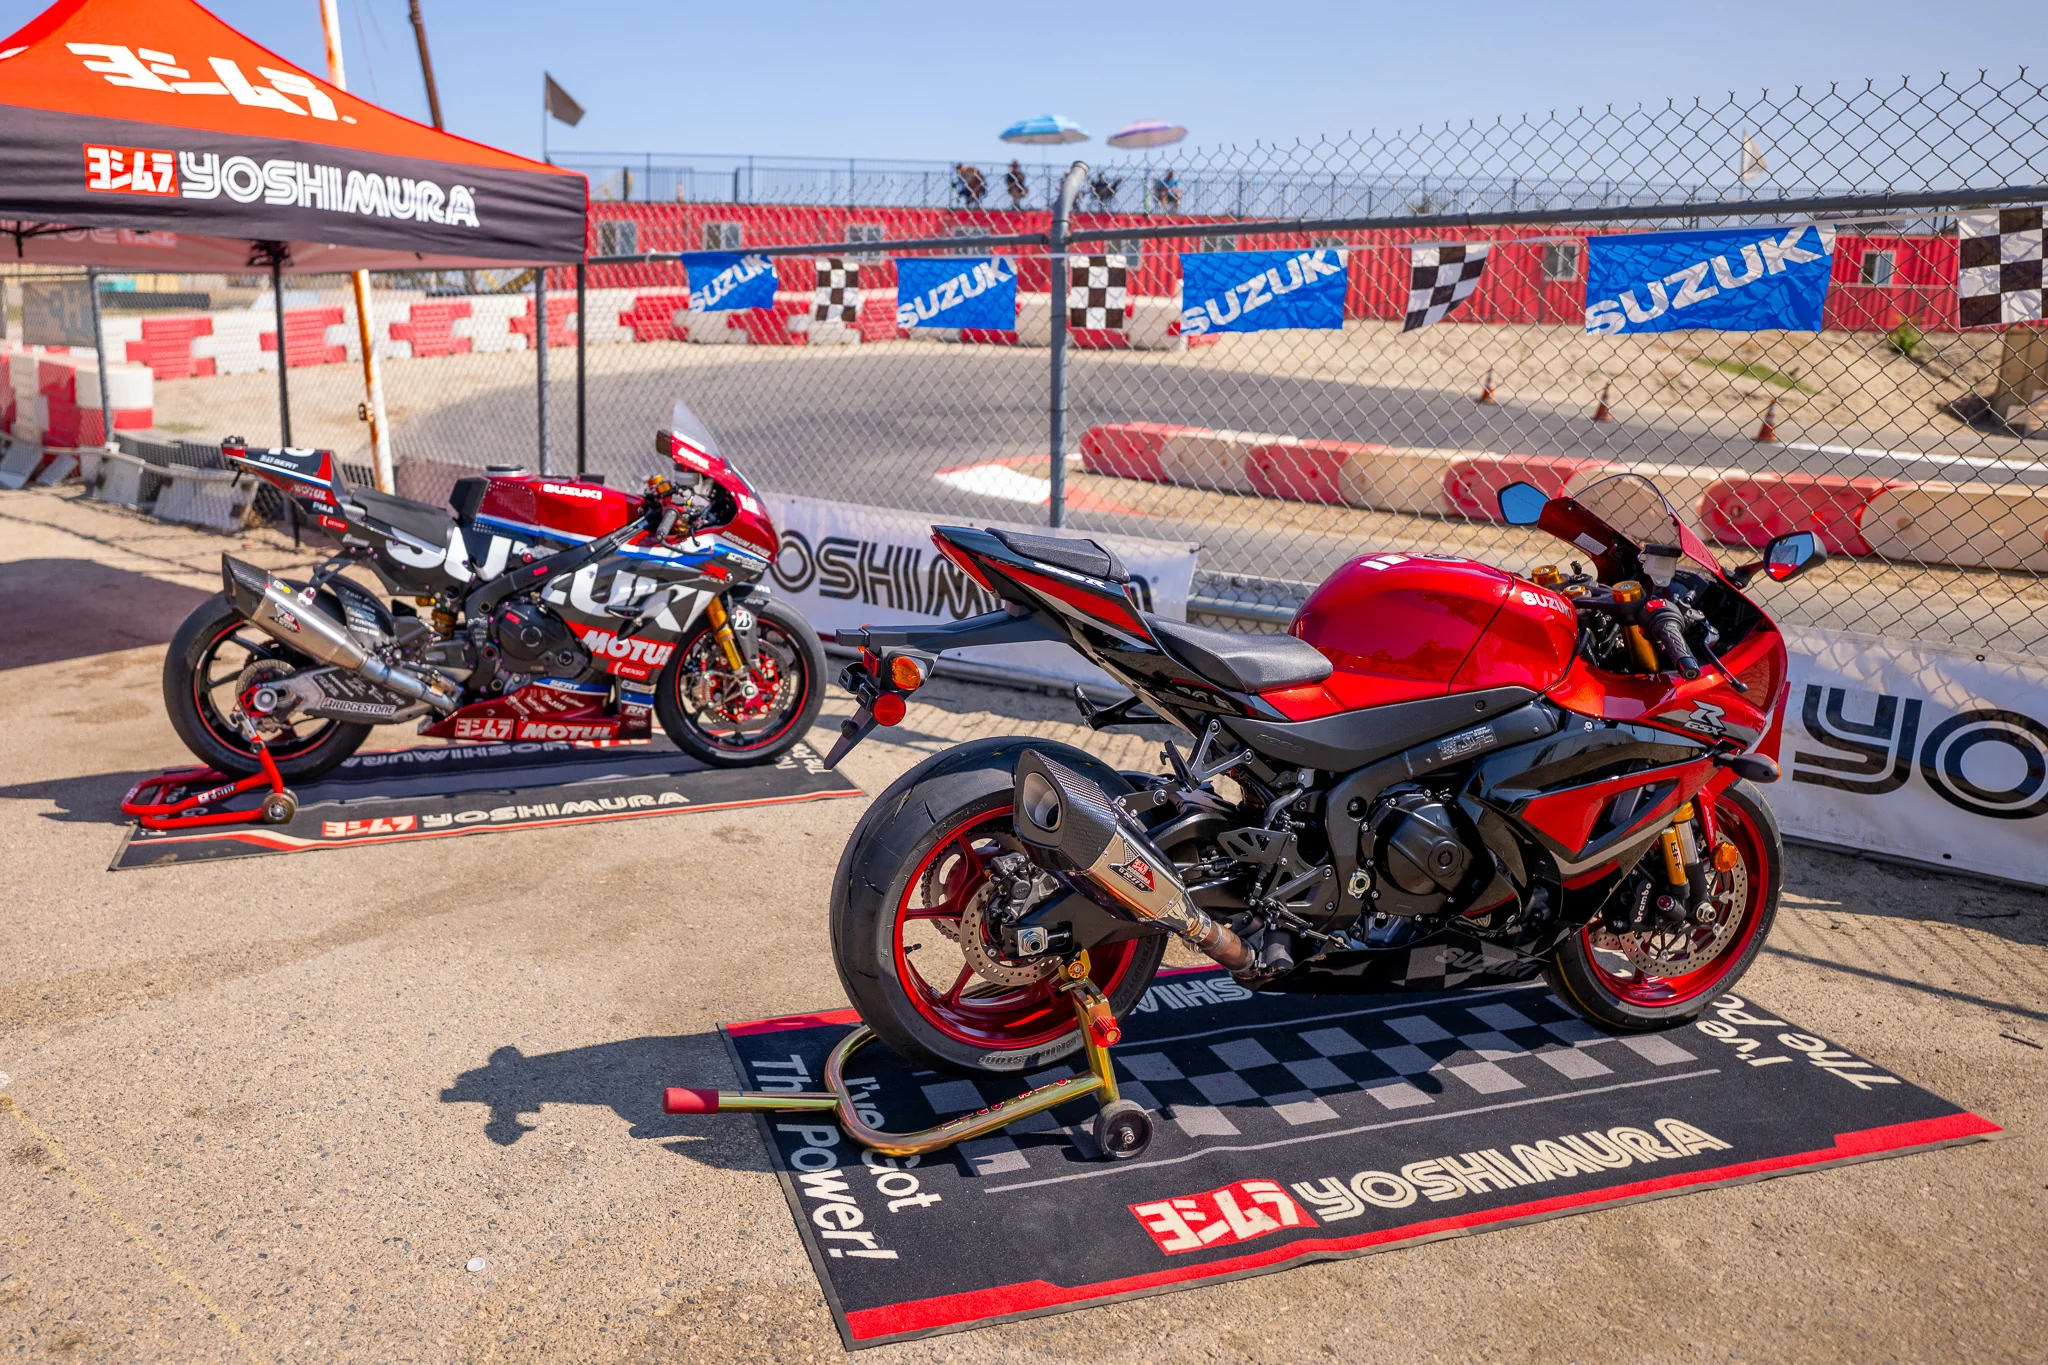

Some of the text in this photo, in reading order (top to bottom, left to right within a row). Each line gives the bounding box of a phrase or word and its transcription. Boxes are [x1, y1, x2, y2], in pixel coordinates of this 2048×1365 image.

[179, 150, 480, 228] YOSHIMURA
[543, 484, 603, 500] SUZUKI
[312, 501, 334, 514] PIAA
[549, 679, 581, 691] SERT
[620, 666, 646, 677] DENSO
[625, 705, 649, 717] RK
[521, 723, 614, 739] MOTUL
[1684, 720, 1724, 736] GSX
[423, 792, 690, 828] YOSHIMURA
[1634, 882, 1653, 923] brembo
[1434, 948, 1538, 978] SUZUKI
[1695, 1020, 1794, 1068] I've
[1777, 1032, 1902, 1091] The
[751, 1054, 900, 1260] Th Power!
[1292, 1118, 1734, 1222] YOSHIMURA
